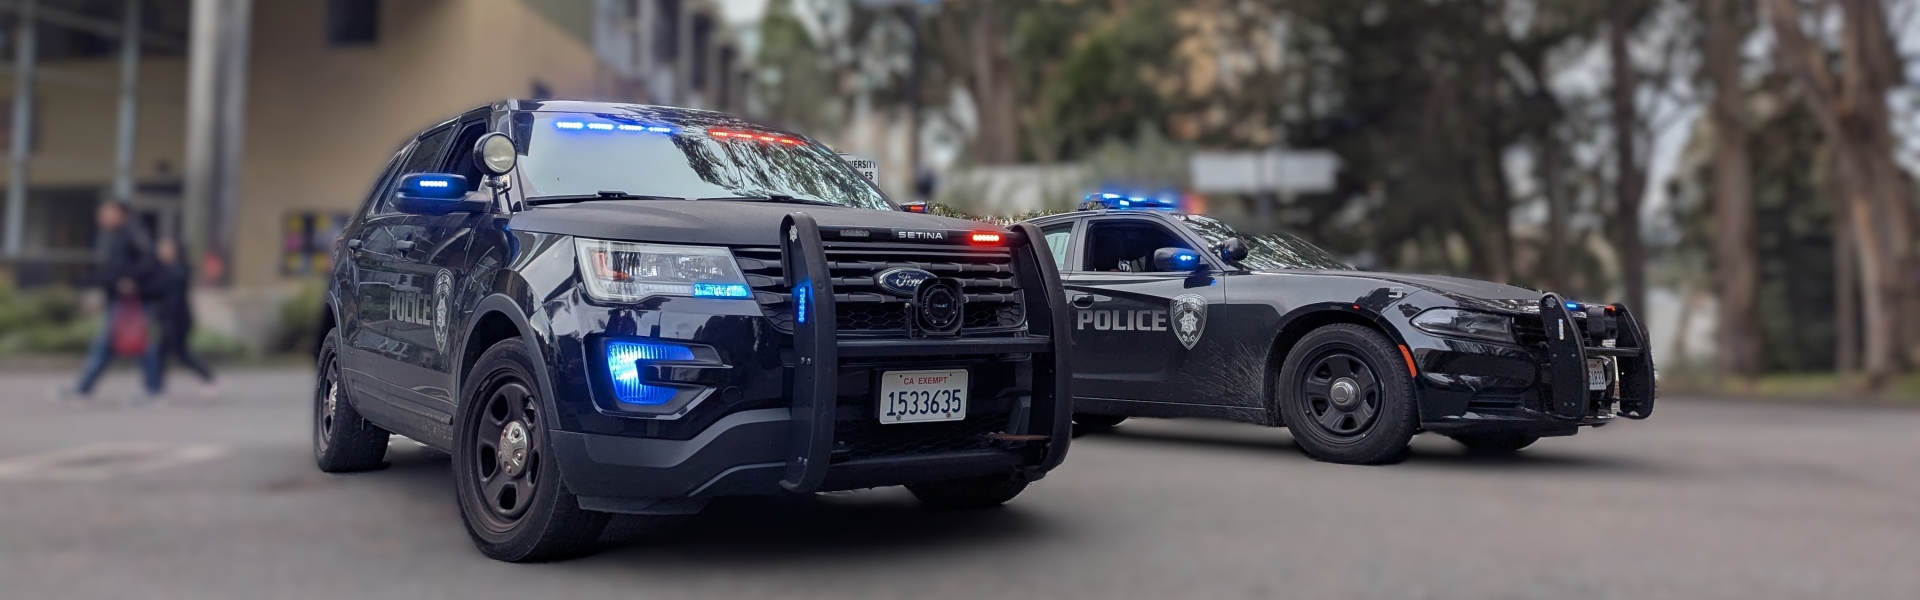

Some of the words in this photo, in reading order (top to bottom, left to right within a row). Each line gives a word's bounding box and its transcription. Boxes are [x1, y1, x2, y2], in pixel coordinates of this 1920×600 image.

[898, 231, 943, 240] SETINA
[389, 290, 432, 326] POLICE
[1077, 309, 1167, 331] POLICE
[903, 377, 915, 385] CA
[918, 376, 948, 385] EXEMPT
[886, 388, 962, 417] 1533635
